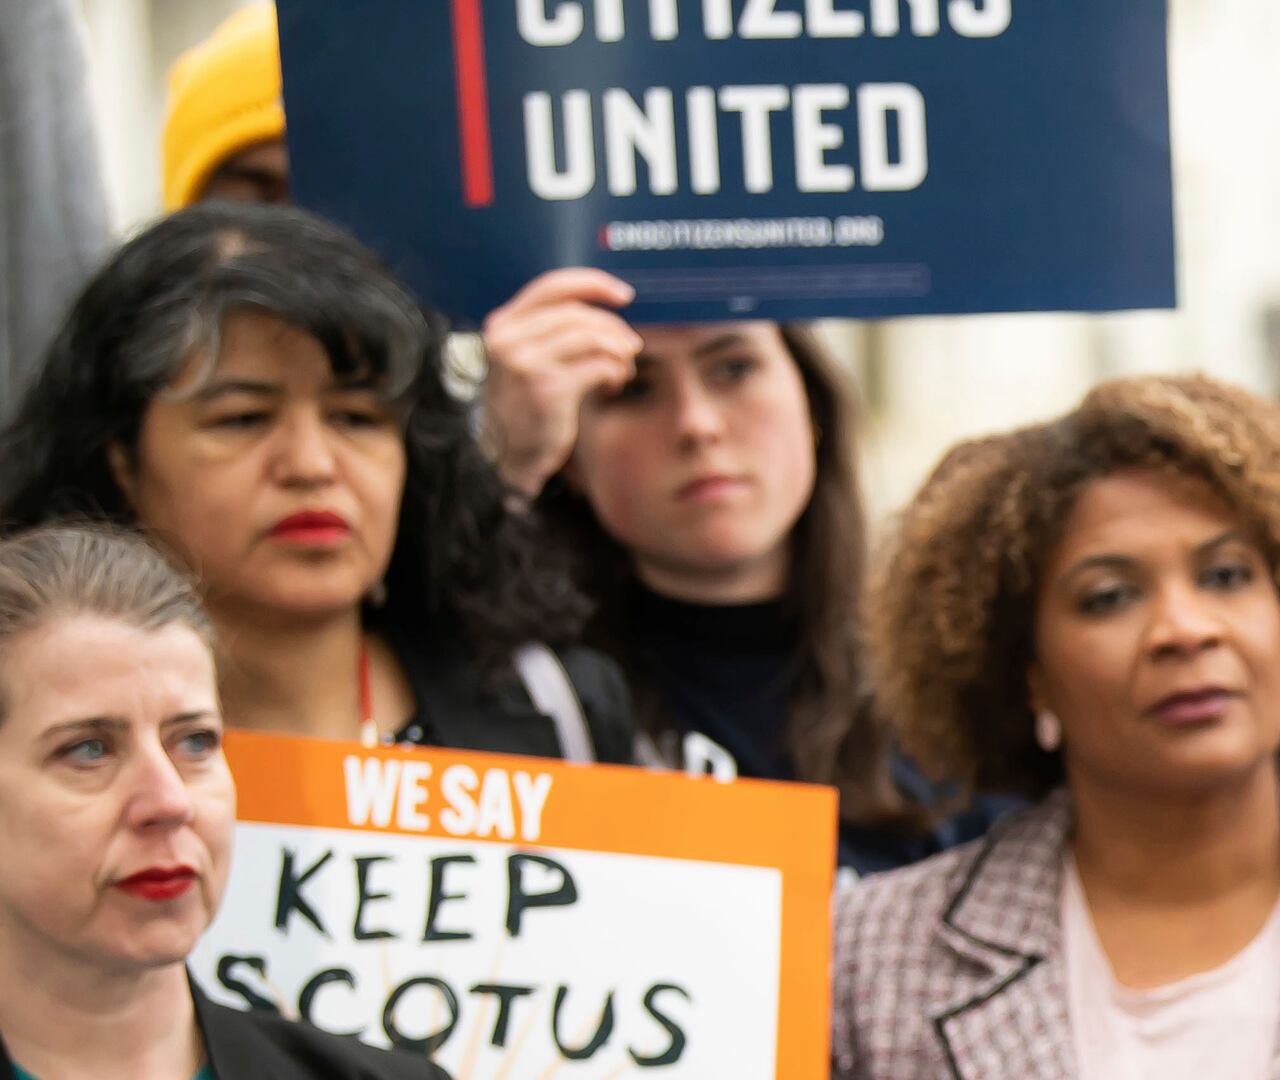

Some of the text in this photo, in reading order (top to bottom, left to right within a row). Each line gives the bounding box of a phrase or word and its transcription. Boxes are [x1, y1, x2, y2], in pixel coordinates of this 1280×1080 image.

[525, 82, 929, 202] UNITED
[344, 756, 553, 842] WE SAY
[274, 847, 578, 942] KEEP
[216, 954, 693, 1068] SCOTUS
